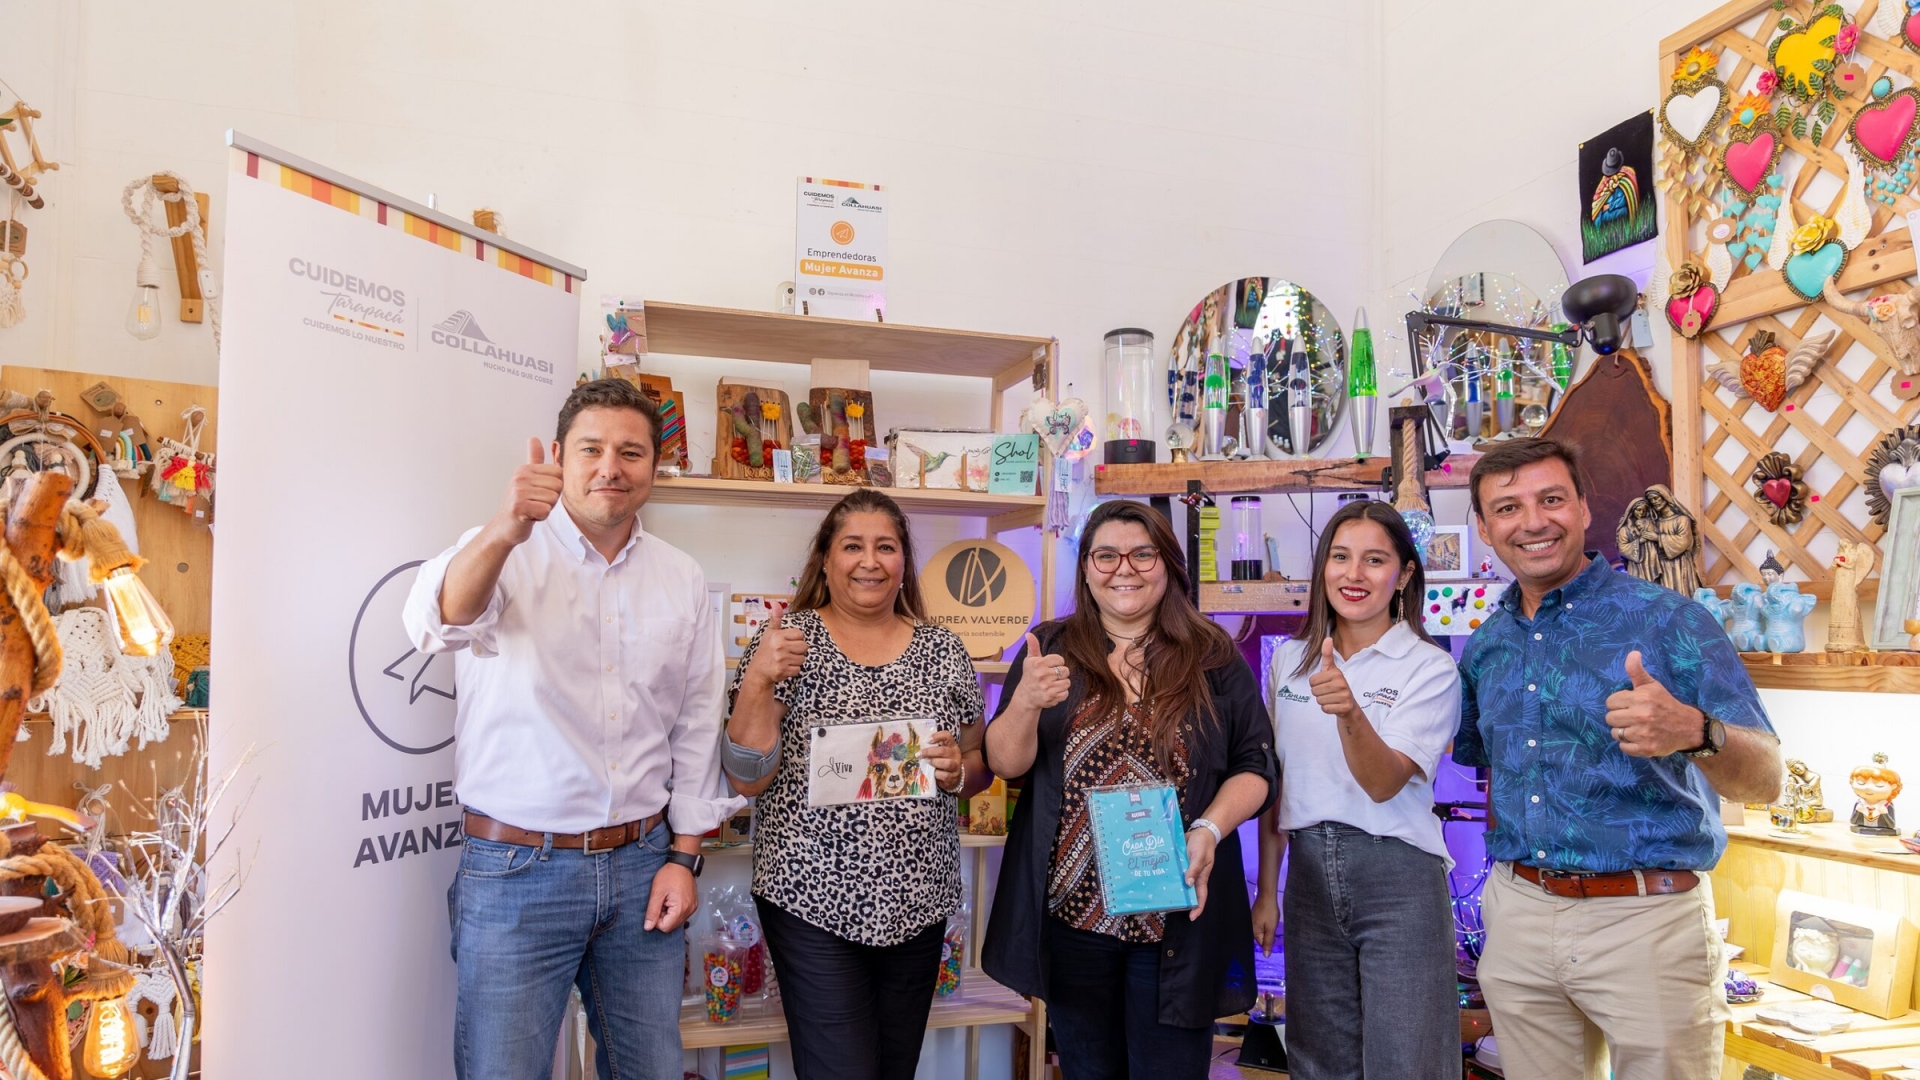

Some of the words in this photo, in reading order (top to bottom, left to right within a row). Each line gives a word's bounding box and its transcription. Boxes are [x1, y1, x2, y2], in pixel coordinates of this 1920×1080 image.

[803, 191, 835, 199] CUIDEMOS
[807, 248, 877, 262] Emprendedoras
[288, 257, 406, 307] CUIDEMOS
[804, 262, 836, 275] Mujer
[838, 265, 879, 278] Avanza
[320, 290, 405, 324] Tarapacá
[302, 317, 351, 337] CUIDEMOS
[352, 331, 364, 340] LO
[364, 335, 405, 351] NUESTRO
[431, 330, 554, 374] COLLAHUASI
[483, 361, 506, 373] MUCHO
[520, 371, 534, 381] QUE
[534, 375, 554, 386] COBRE
[994, 441, 1034, 465] Shol
[744, 466, 774, 479] IQUIQU
[929, 615, 968, 625] NDREA
[970, 615, 1029, 625] VALVERDE
[835, 762, 853, 773] Vive
[353, 820, 463, 868] AVANZ
